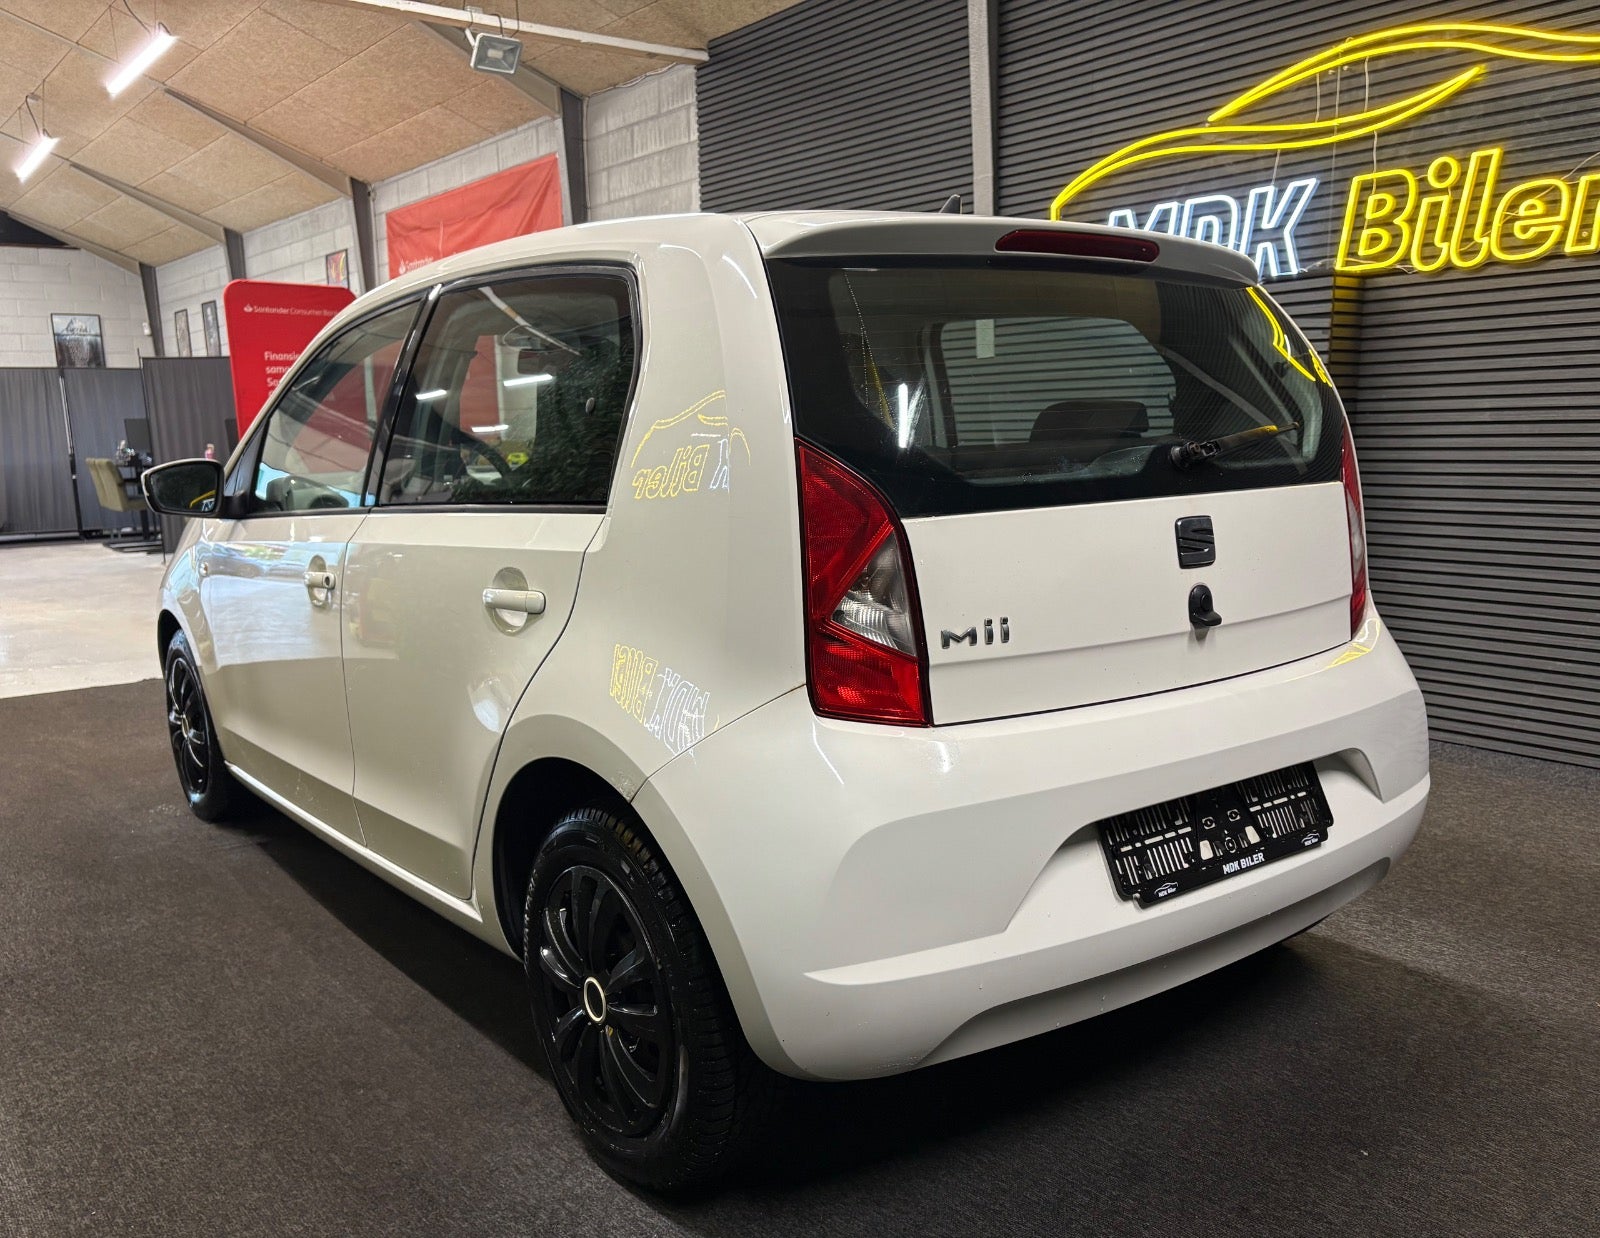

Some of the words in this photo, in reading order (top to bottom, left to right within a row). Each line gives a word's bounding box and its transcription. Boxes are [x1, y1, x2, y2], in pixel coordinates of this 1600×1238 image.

[1334, 147, 1600, 272] Biler
[253, 305, 290, 315] Santander
[290, 307, 323, 316] Consumer
[941, 616, 1010, 649] Mii
[1222, 860, 1241, 874] MDK
[1240, 852, 1265, 868] BILER
